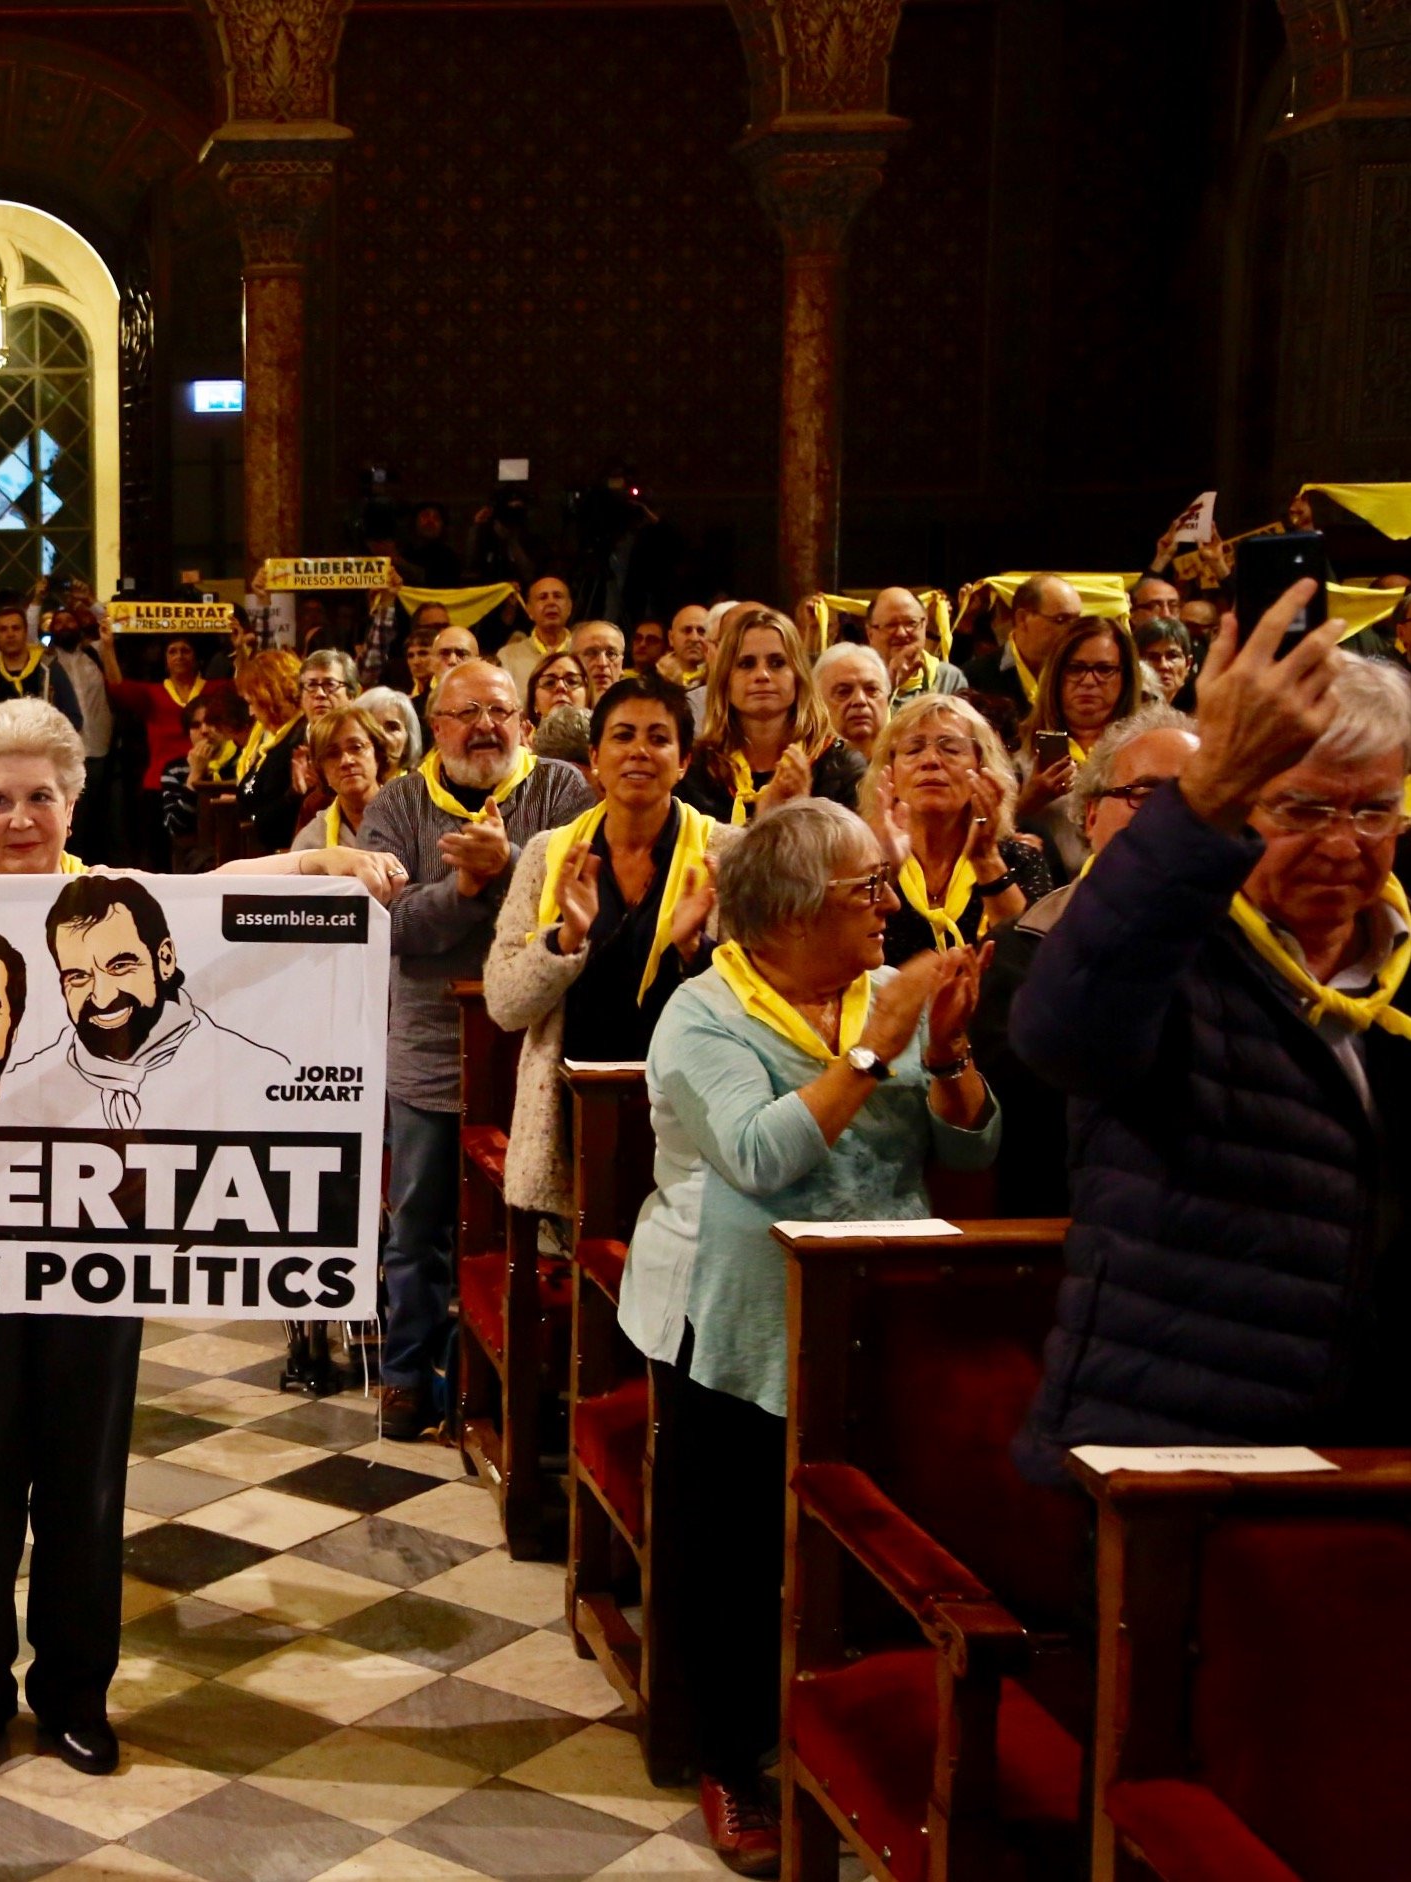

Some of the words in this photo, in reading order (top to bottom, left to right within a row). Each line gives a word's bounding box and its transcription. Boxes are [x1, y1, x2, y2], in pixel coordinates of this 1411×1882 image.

[294, 561, 385, 574] LLIBERTAT
[294, 575, 335, 586] PRESOS
[136, 606, 227, 618] LLIBERTAT
[136, 619, 177, 630] PRESOS
[235, 910, 357, 927] assemblea.cat
[294, 1066, 363, 1082] JORDI
[265, 1085, 364, 1102] CUIXART
[25, 1244, 358, 1309] POLÍTICS
